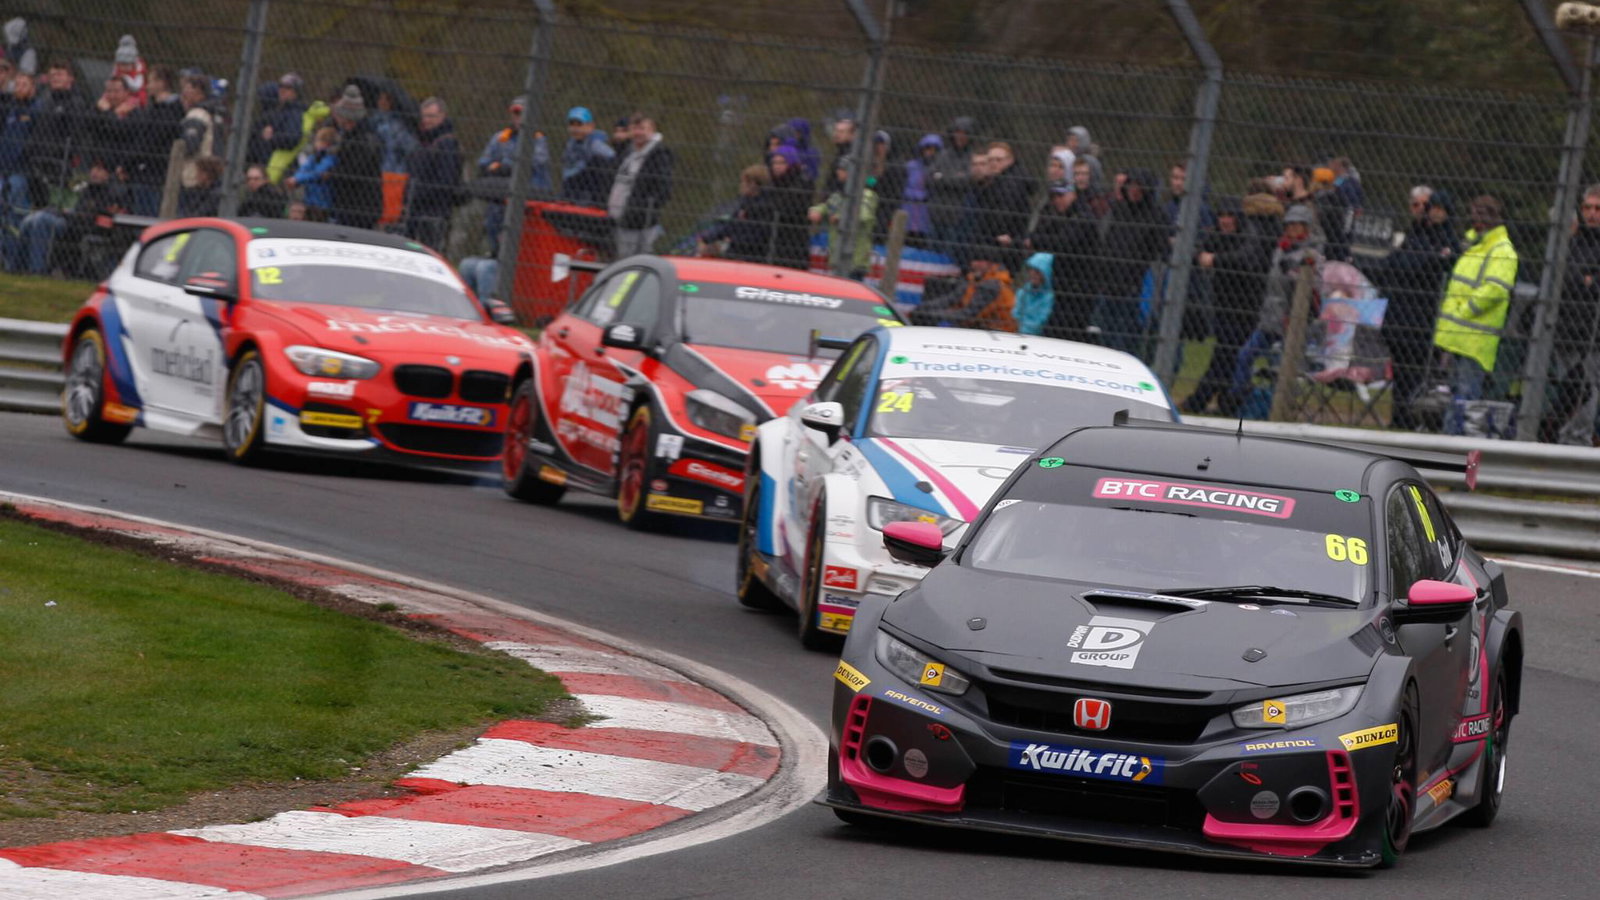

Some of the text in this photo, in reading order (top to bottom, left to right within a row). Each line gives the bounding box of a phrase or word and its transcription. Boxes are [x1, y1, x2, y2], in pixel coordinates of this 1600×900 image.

[255, 267, 282, 284] 12
[922, 343, 1122, 370] FREDDIE WEEKS
[911, 360, 1144, 394] TradePriceCars.com
[877, 391, 914, 413] 24
[1101, 480, 1280, 512] BTC RACING
[1325, 533, 1369, 566] 66
[1082, 627, 1142, 650] D
[1078, 652, 1130, 661] GROUP
[838, 666, 865, 686] DUNLOP
[884, 689, 944, 715] RAVENOL
[1245, 739, 1316, 751] RAVENOL
[1355, 728, 1397, 745] DUNLOP
[1019, 743, 1138, 777] KwikFit
